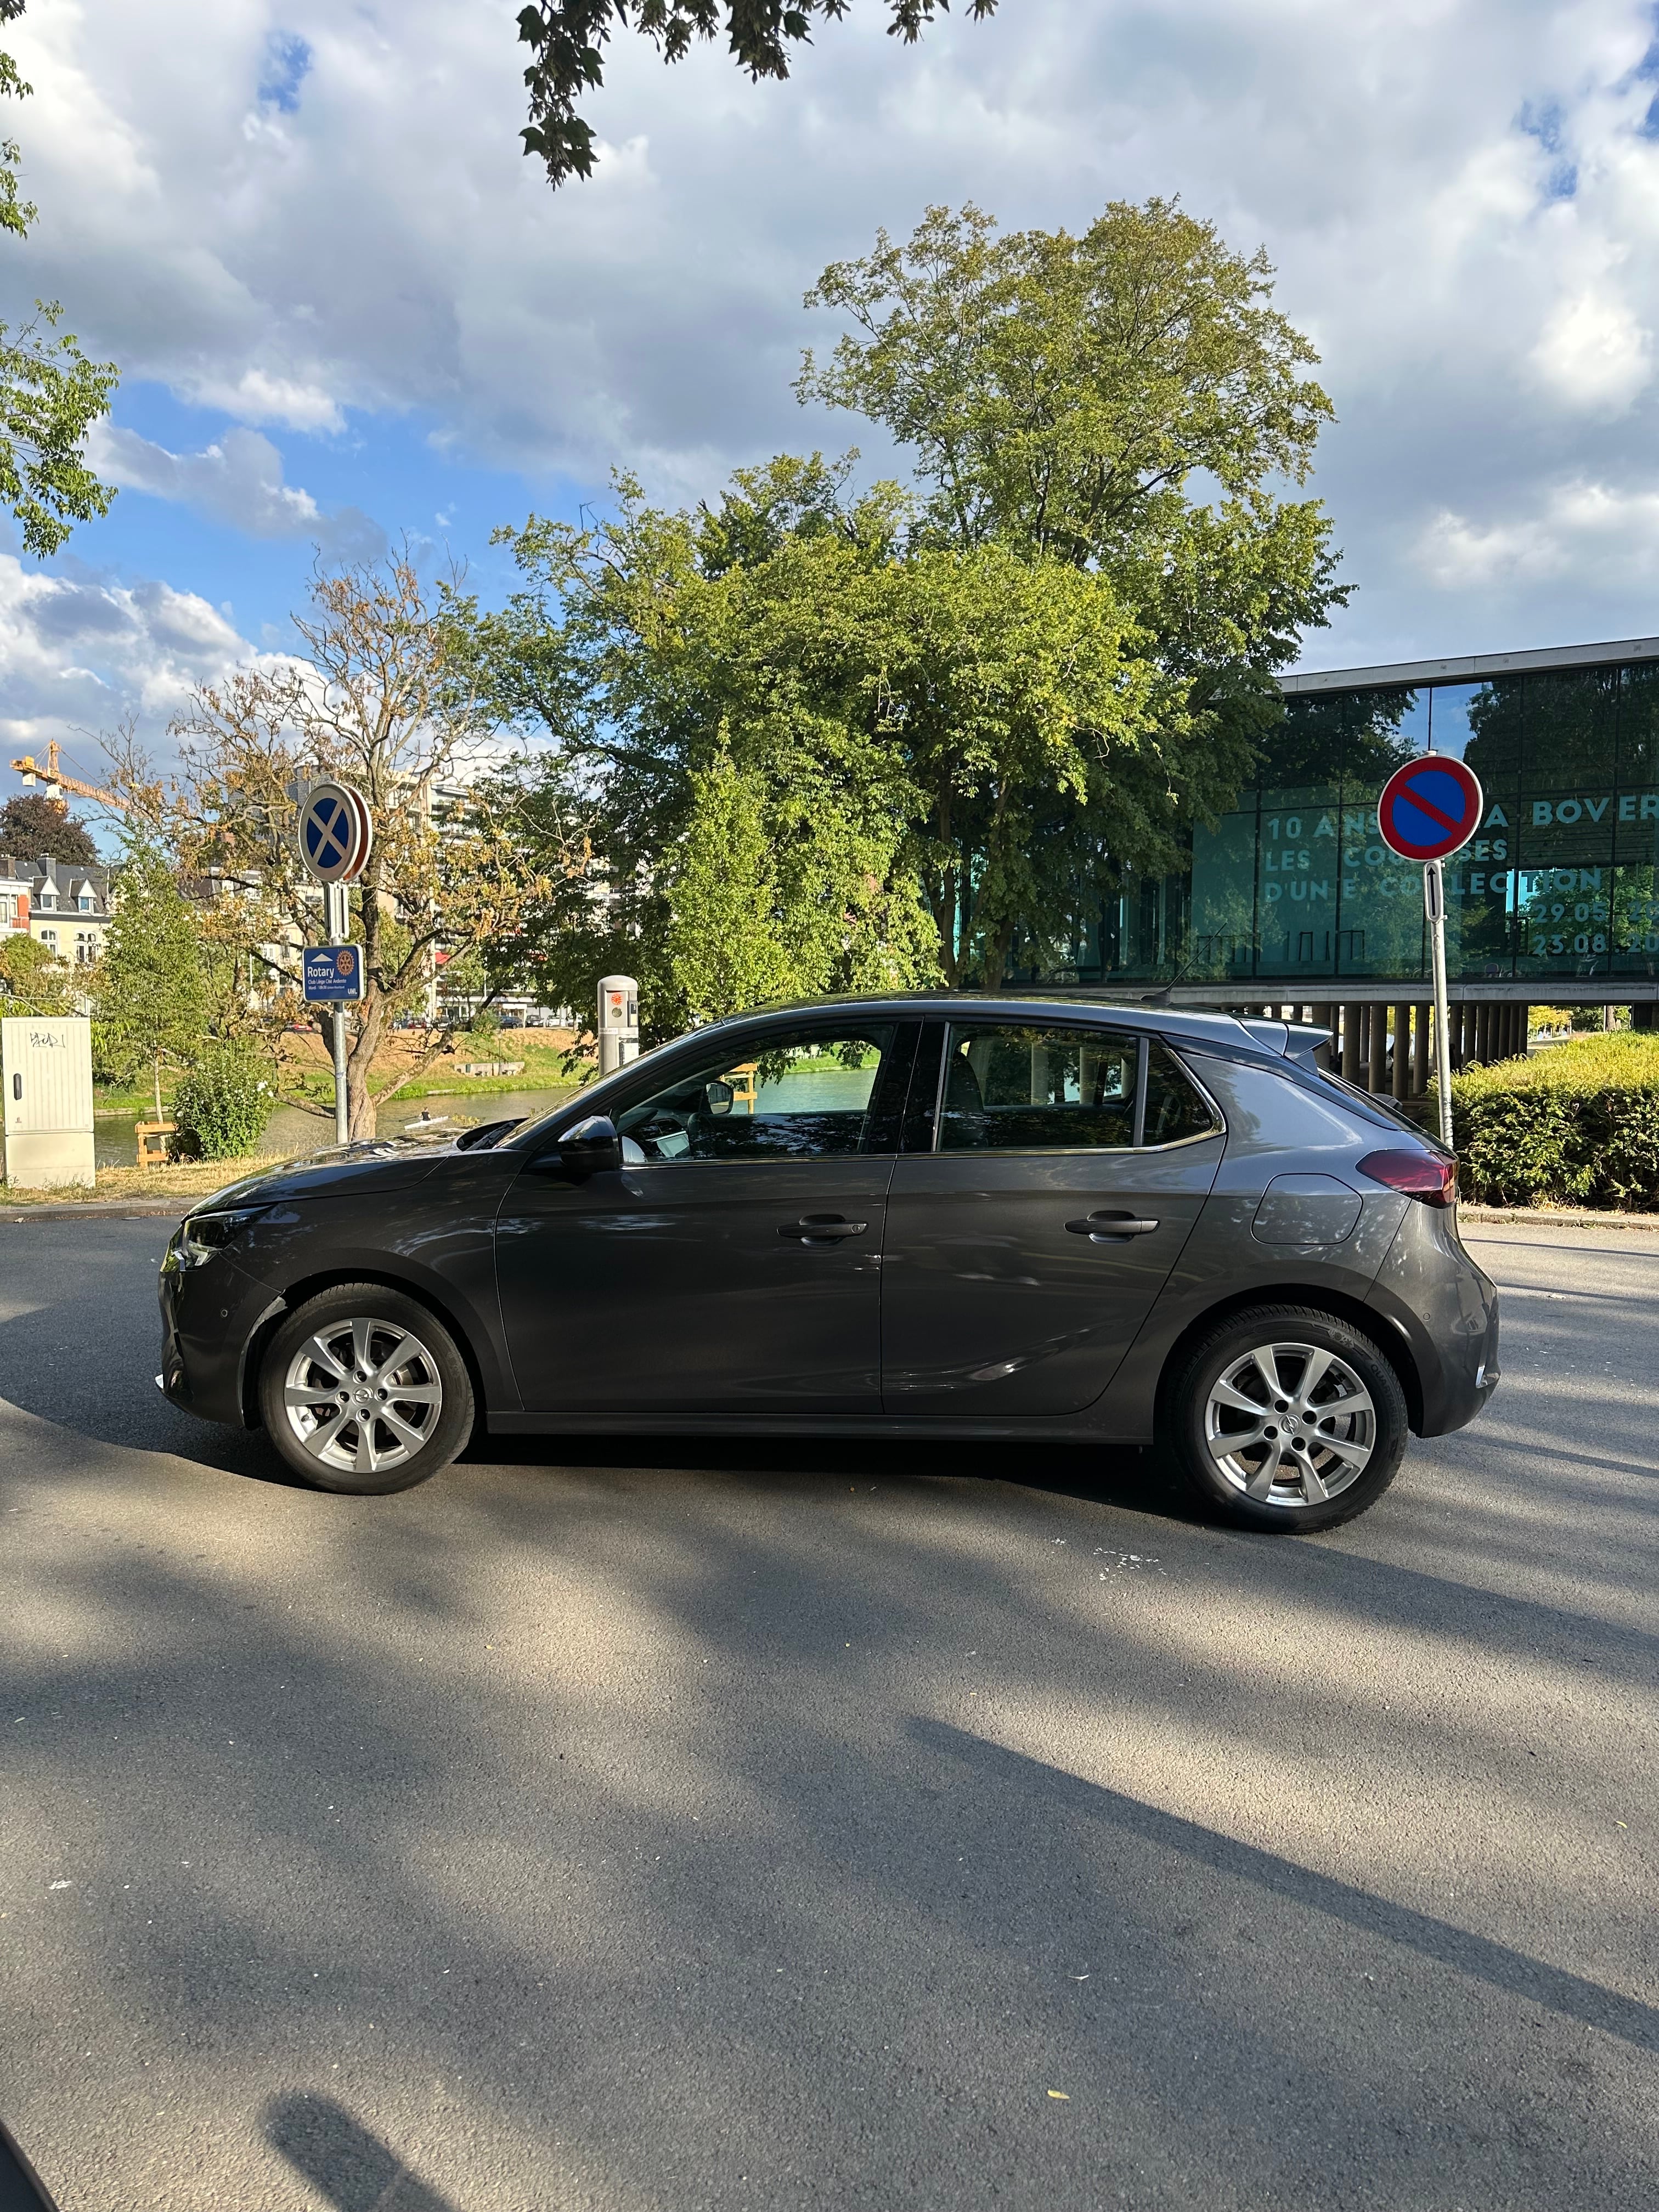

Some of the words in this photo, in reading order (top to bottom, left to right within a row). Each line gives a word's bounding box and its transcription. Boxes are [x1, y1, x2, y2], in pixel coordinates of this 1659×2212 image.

[1267, 816, 1302, 840] 10
[1313, 811, 1379, 838] ANS
[1265, 849, 1311, 872] LES
[1379, 868, 1601, 896] COLECTION
[307, 967, 334, 978] Rotary
